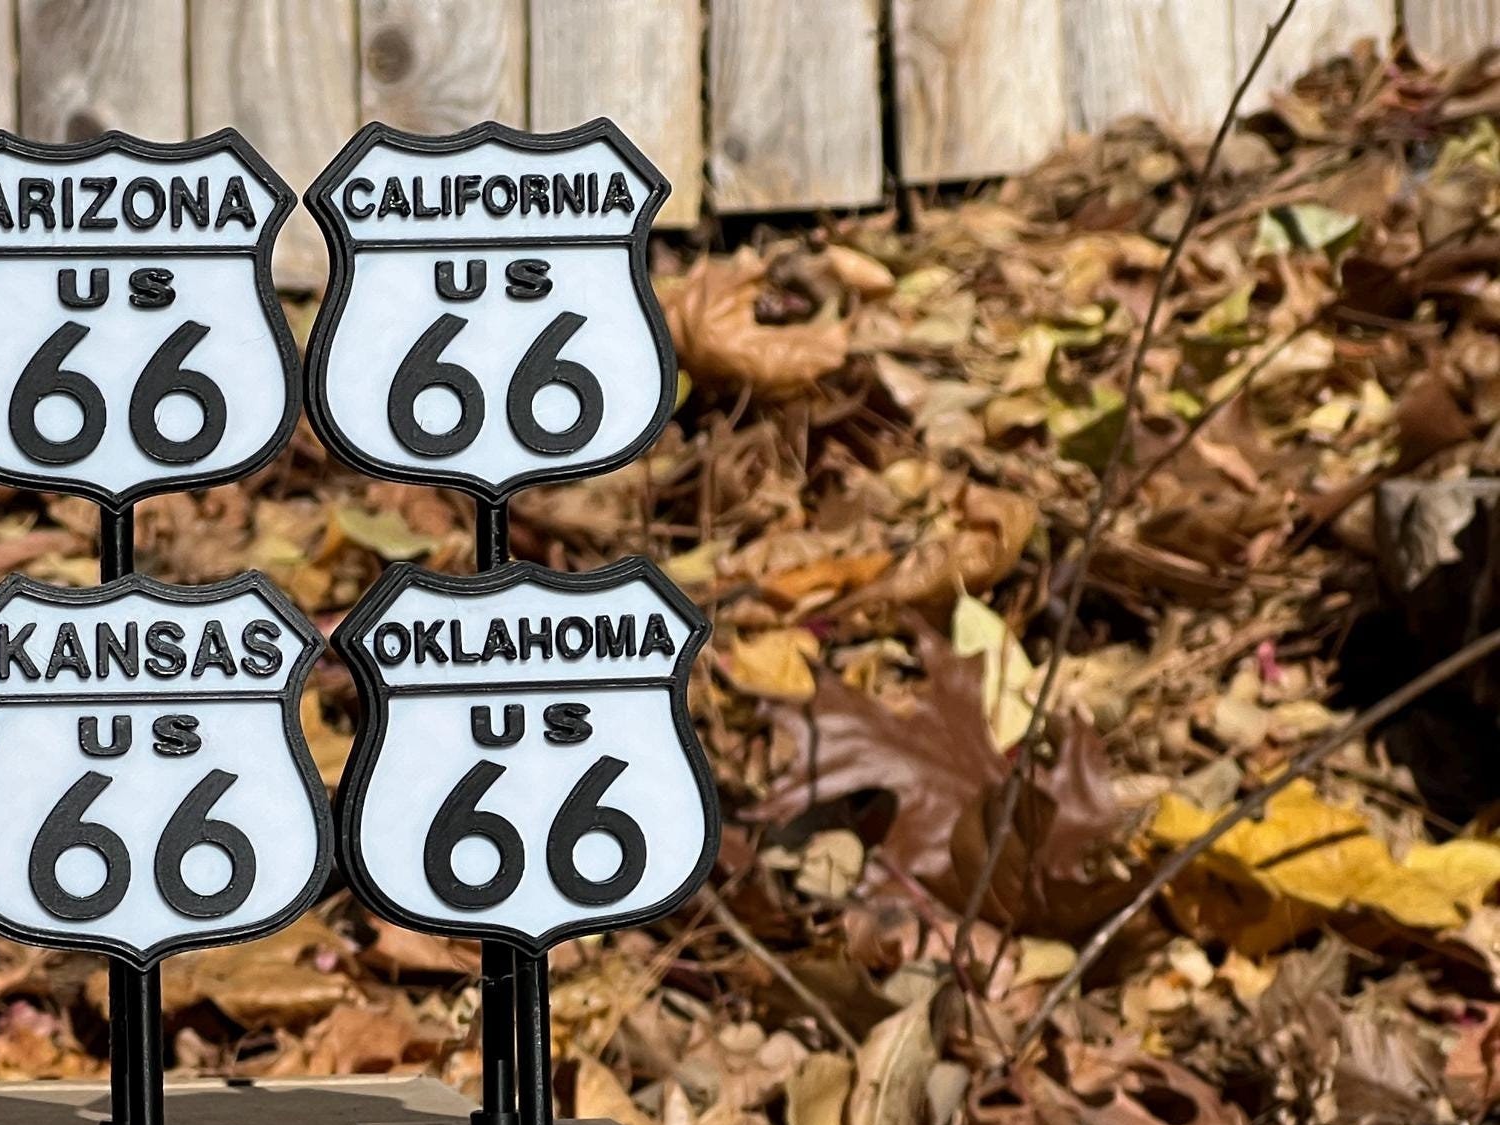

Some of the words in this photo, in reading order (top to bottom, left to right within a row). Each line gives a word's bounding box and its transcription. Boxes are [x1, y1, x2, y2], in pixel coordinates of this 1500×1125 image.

[344, 171, 634, 220] CALIFORNIA
[57, 267, 177, 308] US
[433, 258, 553, 302] US
[9, 320, 227, 465] 66
[388, 311, 604, 457] 66
[371, 612, 676, 667] OKLAHOMA
[78, 714, 202, 756] US
[470, 702, 593, 746] US
[29, 769, 256, 921] 66
[424, 756, 647, 909] 66
